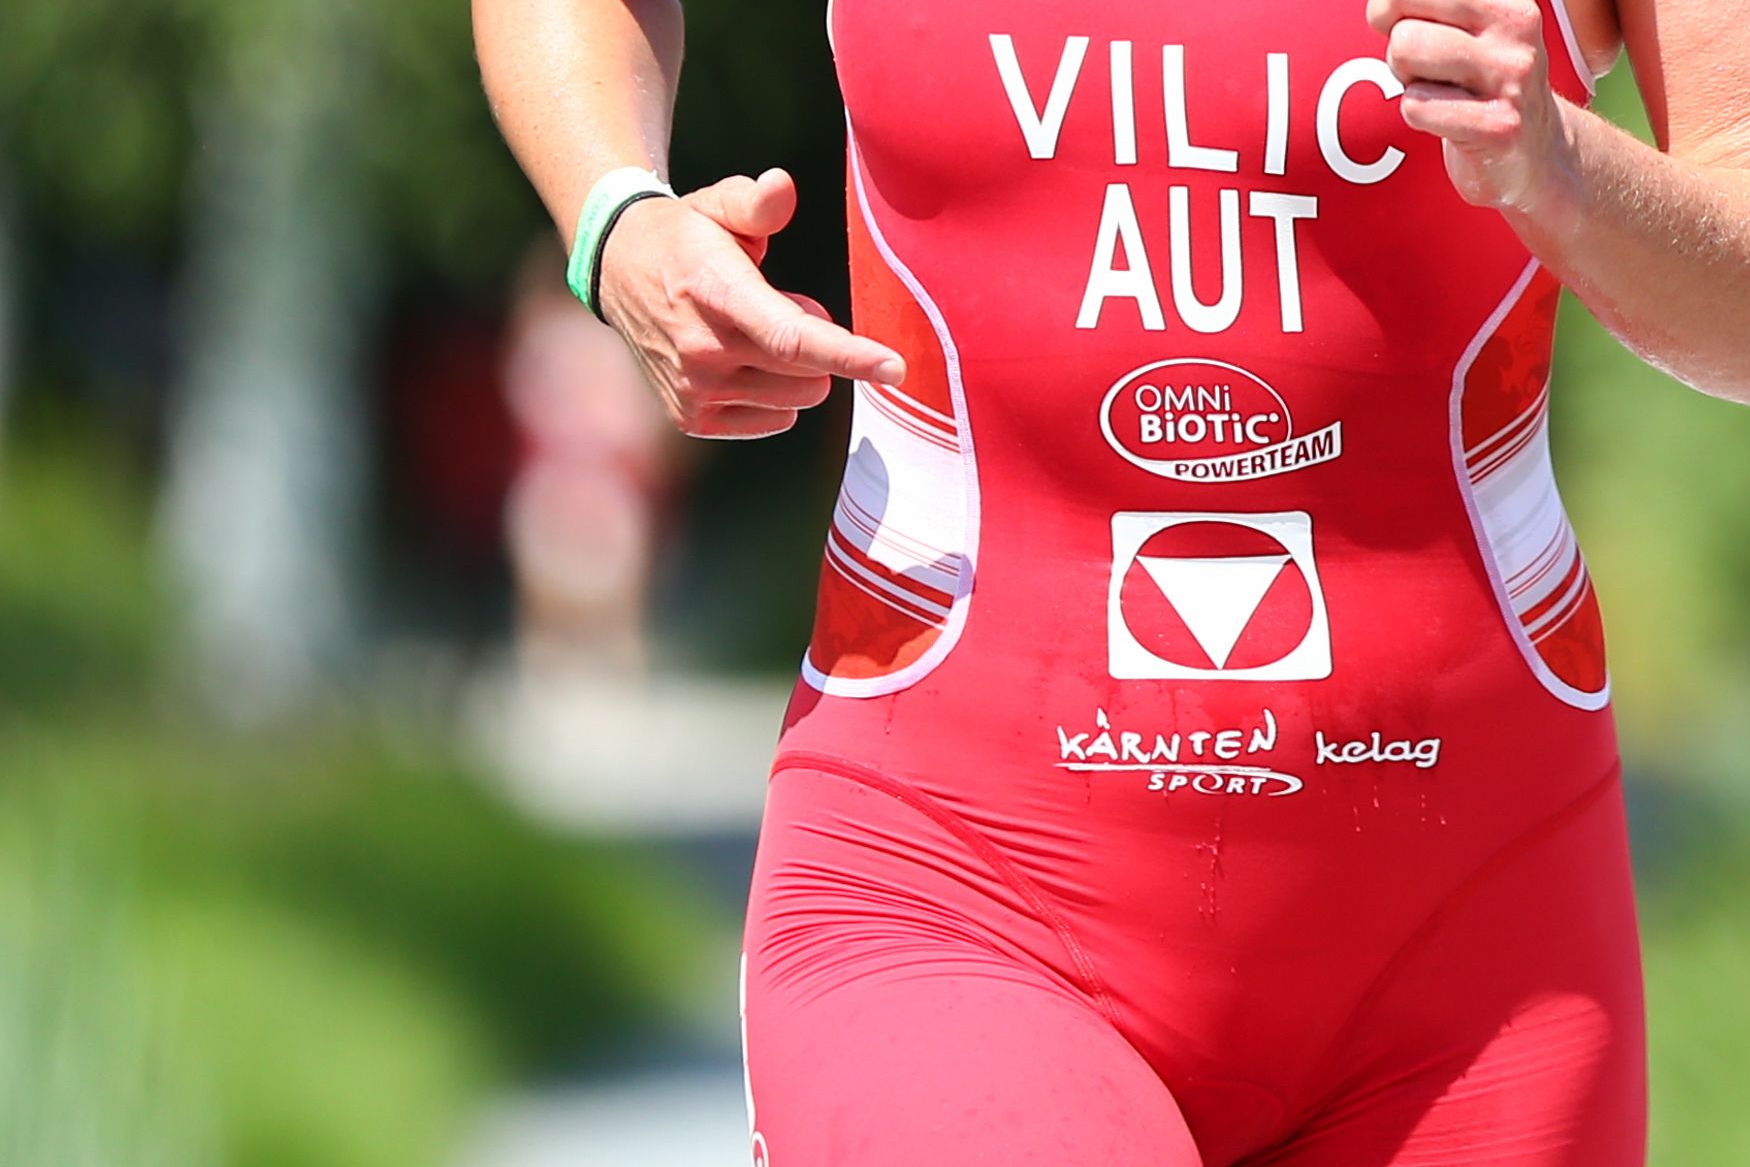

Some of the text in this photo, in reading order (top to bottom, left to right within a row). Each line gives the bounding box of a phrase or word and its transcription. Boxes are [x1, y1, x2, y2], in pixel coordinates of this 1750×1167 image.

[988, 33, 1406, 184] VILIC
[1075, 183, 1318, 333] AUT
[1174, 430, 1334, 479] POWERTEAM
[1315, 731, 1441, 768] kelag
[1148, 773, 1269, 796] SPORT
